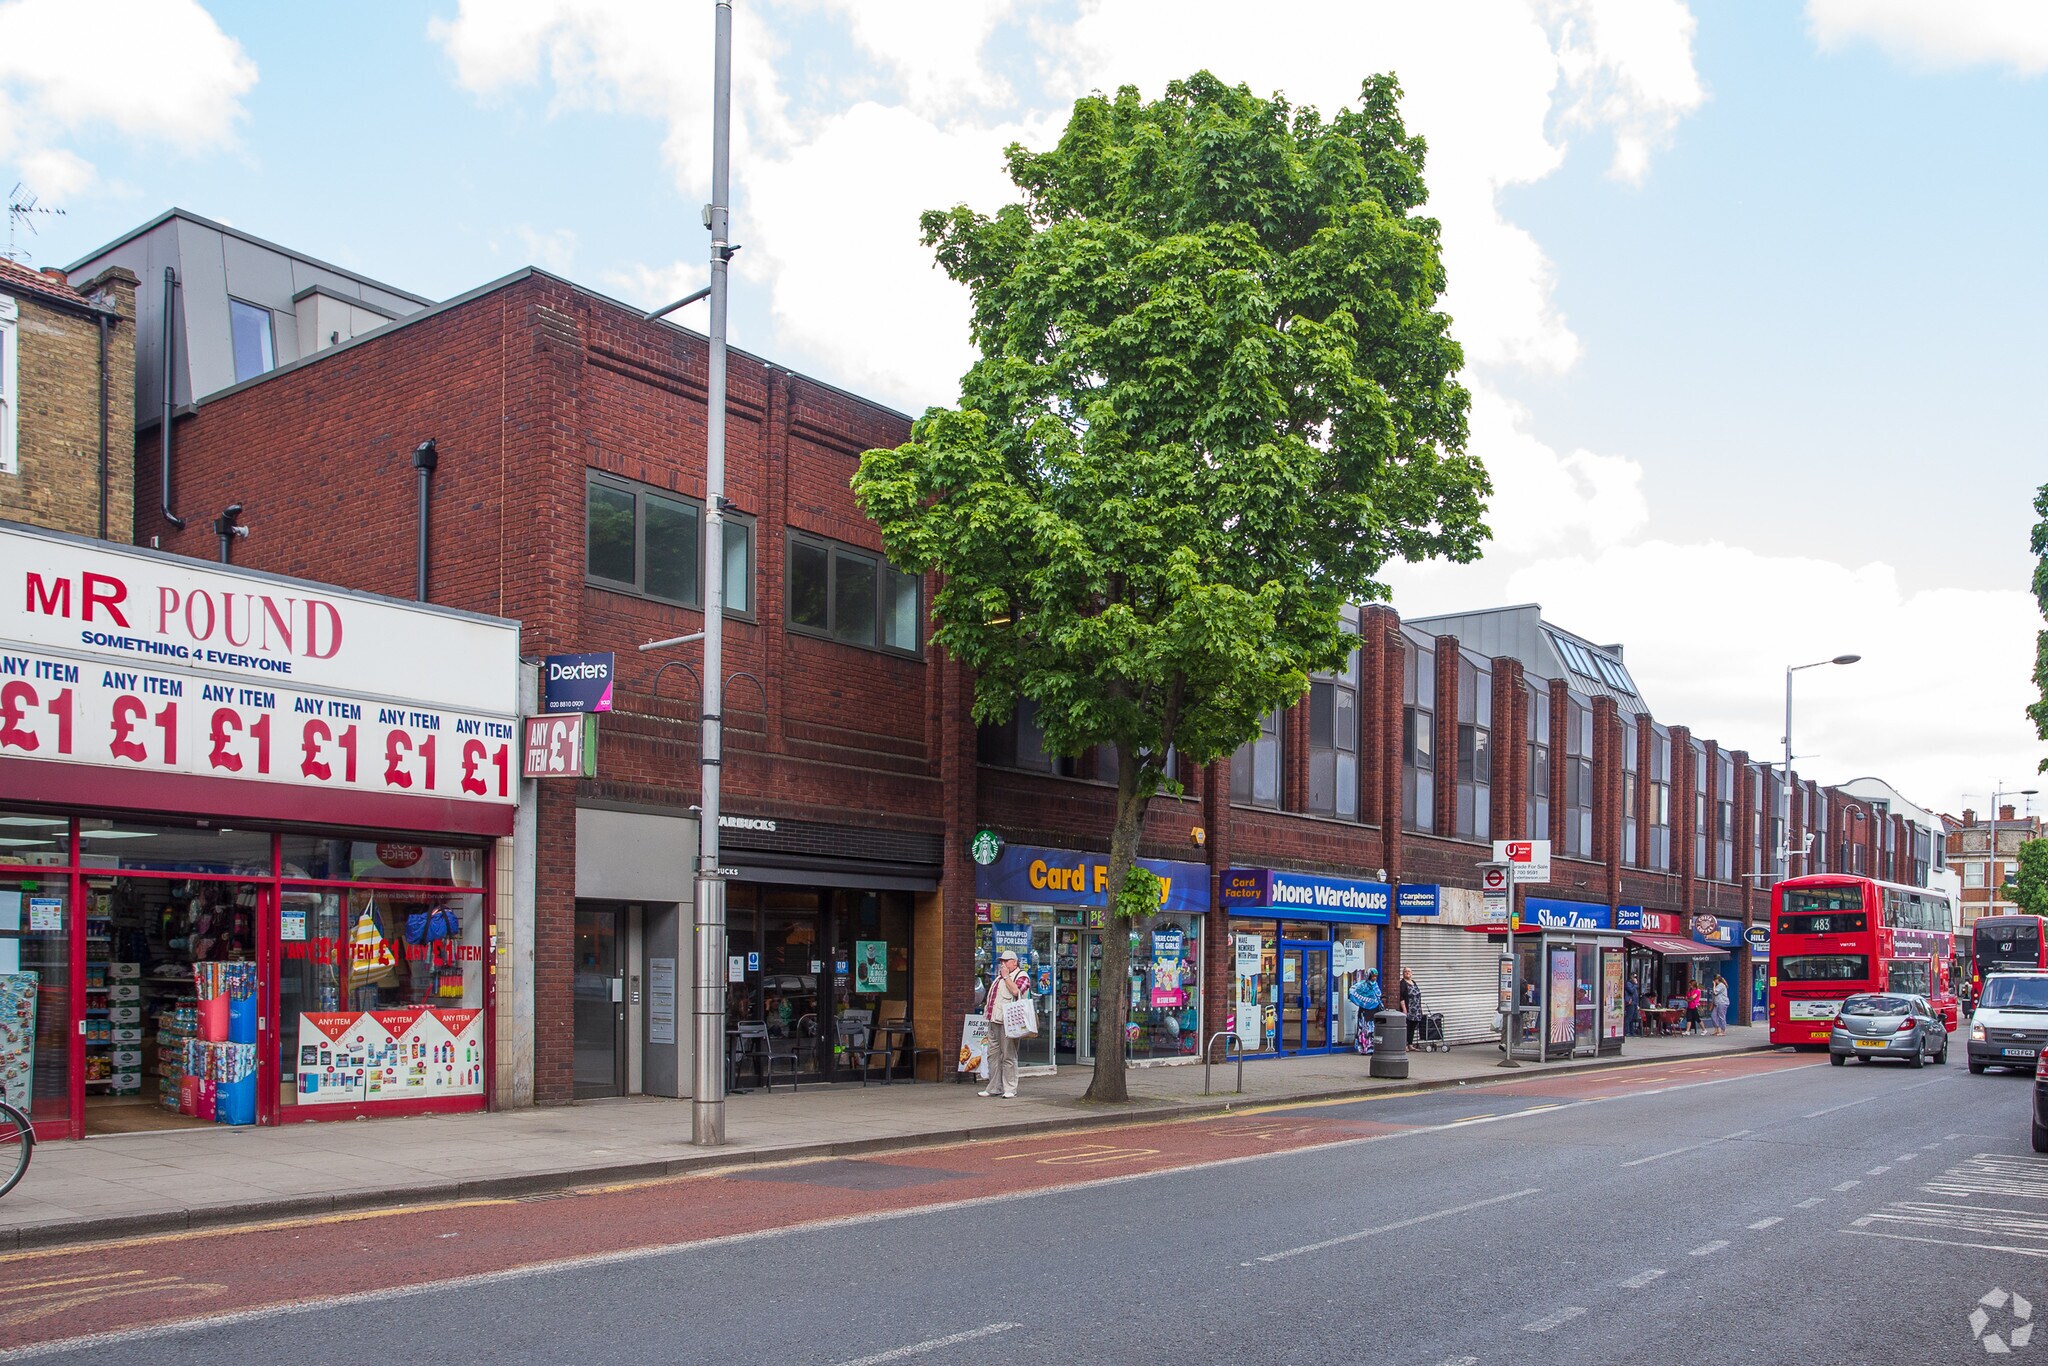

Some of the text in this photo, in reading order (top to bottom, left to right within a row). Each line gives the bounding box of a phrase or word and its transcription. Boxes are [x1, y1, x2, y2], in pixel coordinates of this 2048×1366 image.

[26, 571, 343, 660] MR POUND
[81, 630, 292, 674] SOMETHING 4 EVERYONE
[36, 660, 79, 684] ITEM
[550, 662, 608, 681] Dexters
[102, 671, 183, 698] ANY ITEM
[202, 684, 275, 709] ANY ITEM
[0, 680, 72, 755] £1
[294, 697, 361, 720] ANY ITEM
[379, 708, 440, 730] ANY ITEM
[456, 718, 513, 739] ANY ITEM
[109, 694, 177, 765] £1
[208, 707, 270, 774] £1
[531, 720, 579, 772] ANY £1
[300, 719, 357, 782] £1
[384, 729, 436, 790] £1
[527, 749, 548, 771] ITEM
[461, 739, 508, 797] £1
[718, 816, 776, 832] ARBUCKS
[718, 868, 739, 876] BUCKS
[1029, 859, 1085, 892] Card
[1232, 877, 1255, 887] Card
[1225, 888, 1261, 899] Factory
[1314, 886, 1387, 910] Warehouse
[1538, 909, 1597, 928] Shoe Zone
[1618, 910, 1639, 918] Shoe
[1642, 914, 1660, 929] OSTA
[1005, 930, 1028, 938] WRAPPED
[1814, 918, 1830, 931] 483
[996, 937, 1004, 945] UP
[1004, 937, 1014, 945] FOR
[1751, 934, 1766, 942] HILL
[2001, 943, 2012, 951] 427
[456, 945, 482, 961] ITEM
[318, 1017, 350, 1026] ANY ITEM
[382, 1016, 413, 1024] ANY ITEM
[452, 1023, 460, 1031] £1
[457, 1014, 470, 1022] ITEM
[330, 1027, 338, 1035] £1
[393, 1025, 401, 1033] £1
